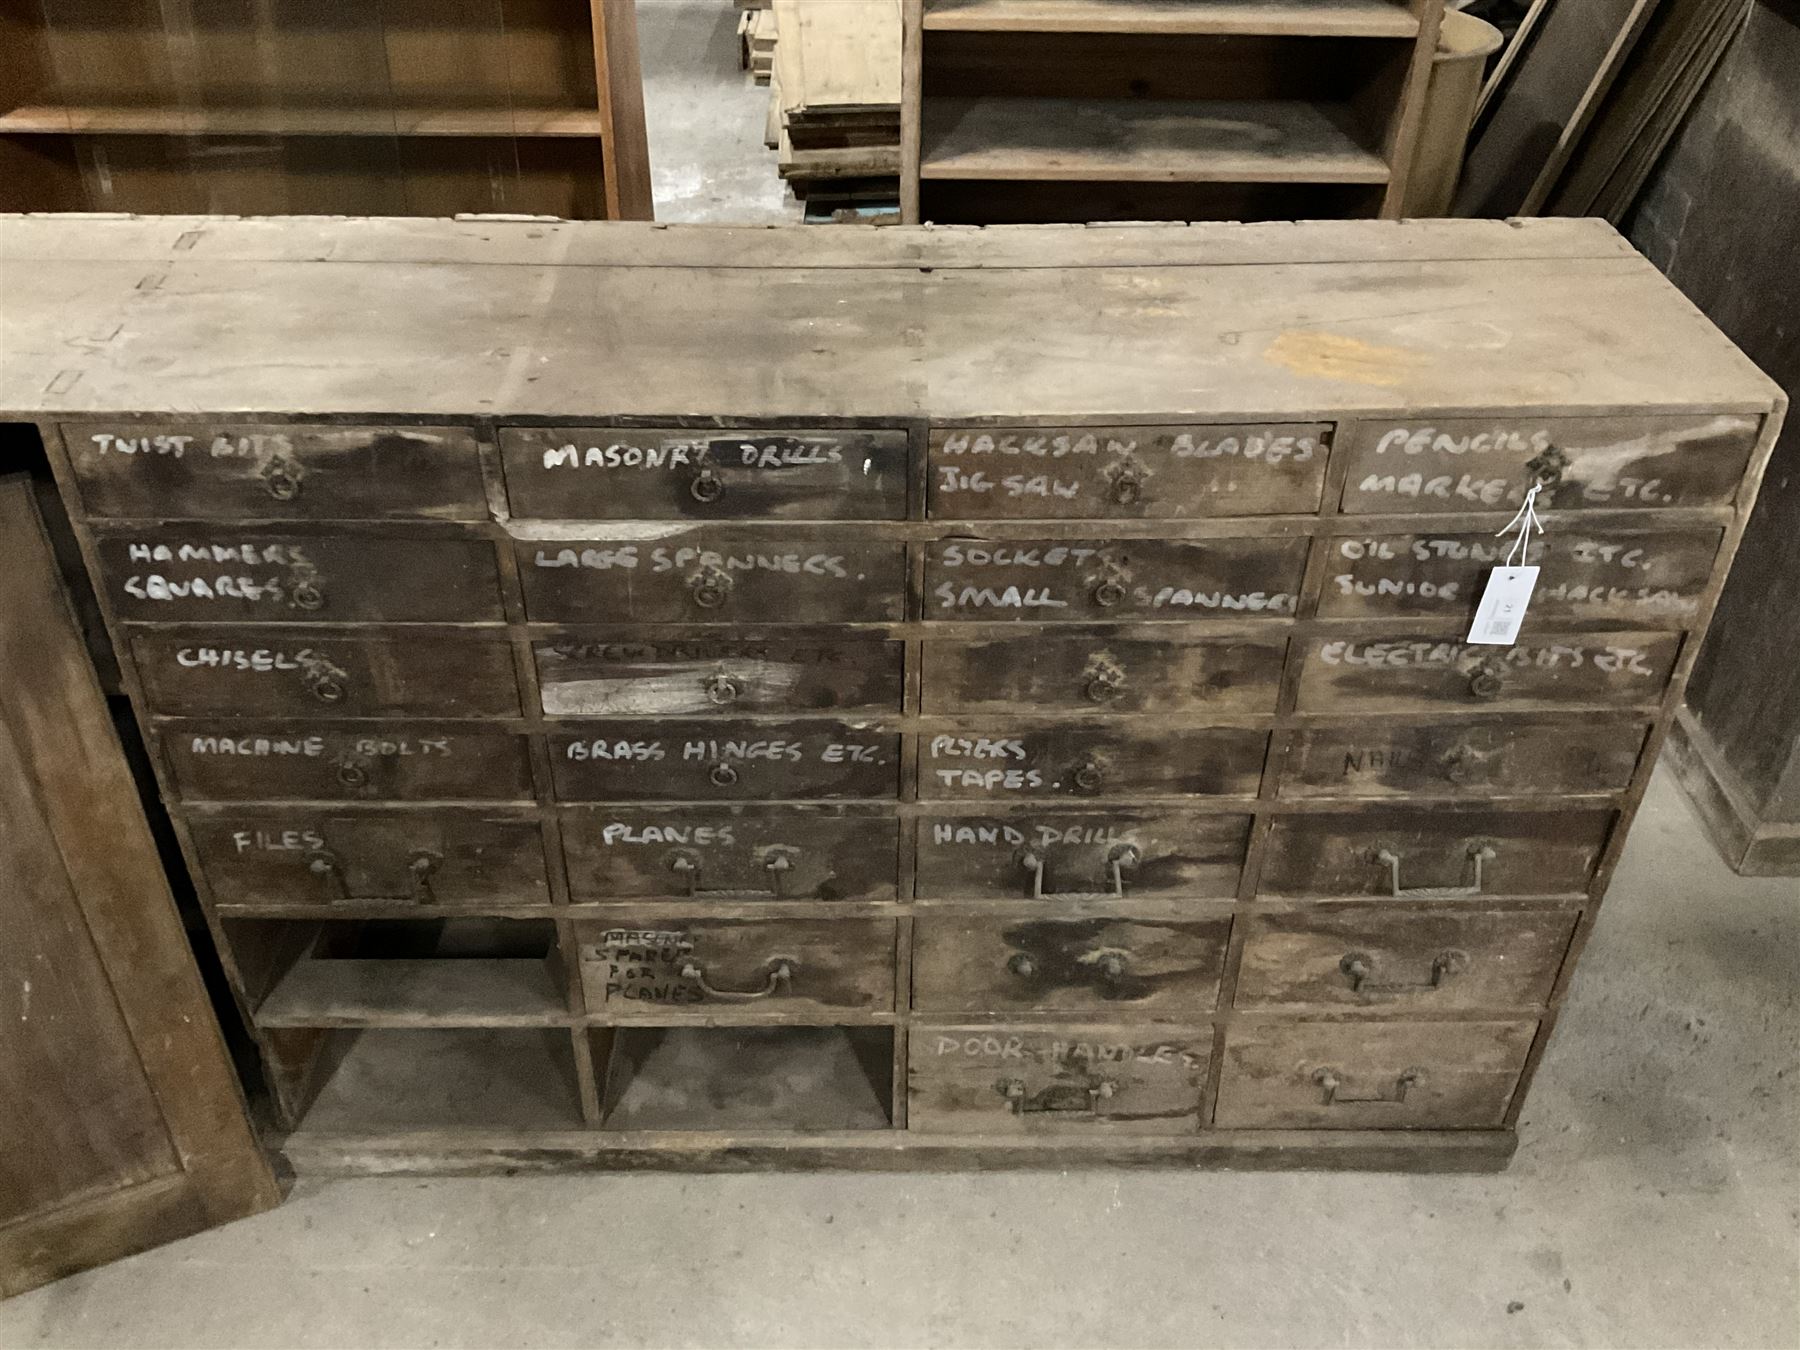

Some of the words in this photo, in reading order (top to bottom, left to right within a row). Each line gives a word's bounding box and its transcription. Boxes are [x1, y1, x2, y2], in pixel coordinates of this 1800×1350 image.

[91, 433, 193, 458] TWIST
[1170, 431, 1315, 463] BLADES
[1375, 428, 1549, 454] PENCILS
[543, 443, 709, 470] MASONRY
[740, 444, 843, 467] DRILLS
[938, 466, 994, 493] JIG
[1001, 475, 1080, 498] SAW
[534, 546, 638, 570] LARGE
[1340, 539, 1395, 561] OIL
[123, 574, 285, 601] SQUARES
[935, 580, 1068, 608] SMALL
[1334, 574, 1460, 600] JUNIOR
[176, 647, 316, 673] CHISELS
[192, 736, 325, 757] MACHINE
[356, 736, 454, 758] BOLTS
[567, 739, 666, 761] BRASS
[683, 739, 802, 762] HINGES
[820, 744, 887, 766] ETC.
[233, 831, 325, 854] FILES
[602, 822, 736, 846] PLANES
[932, 823, 1025, 845] HAND
[936, 1036, 1027, 1060] DOOR
